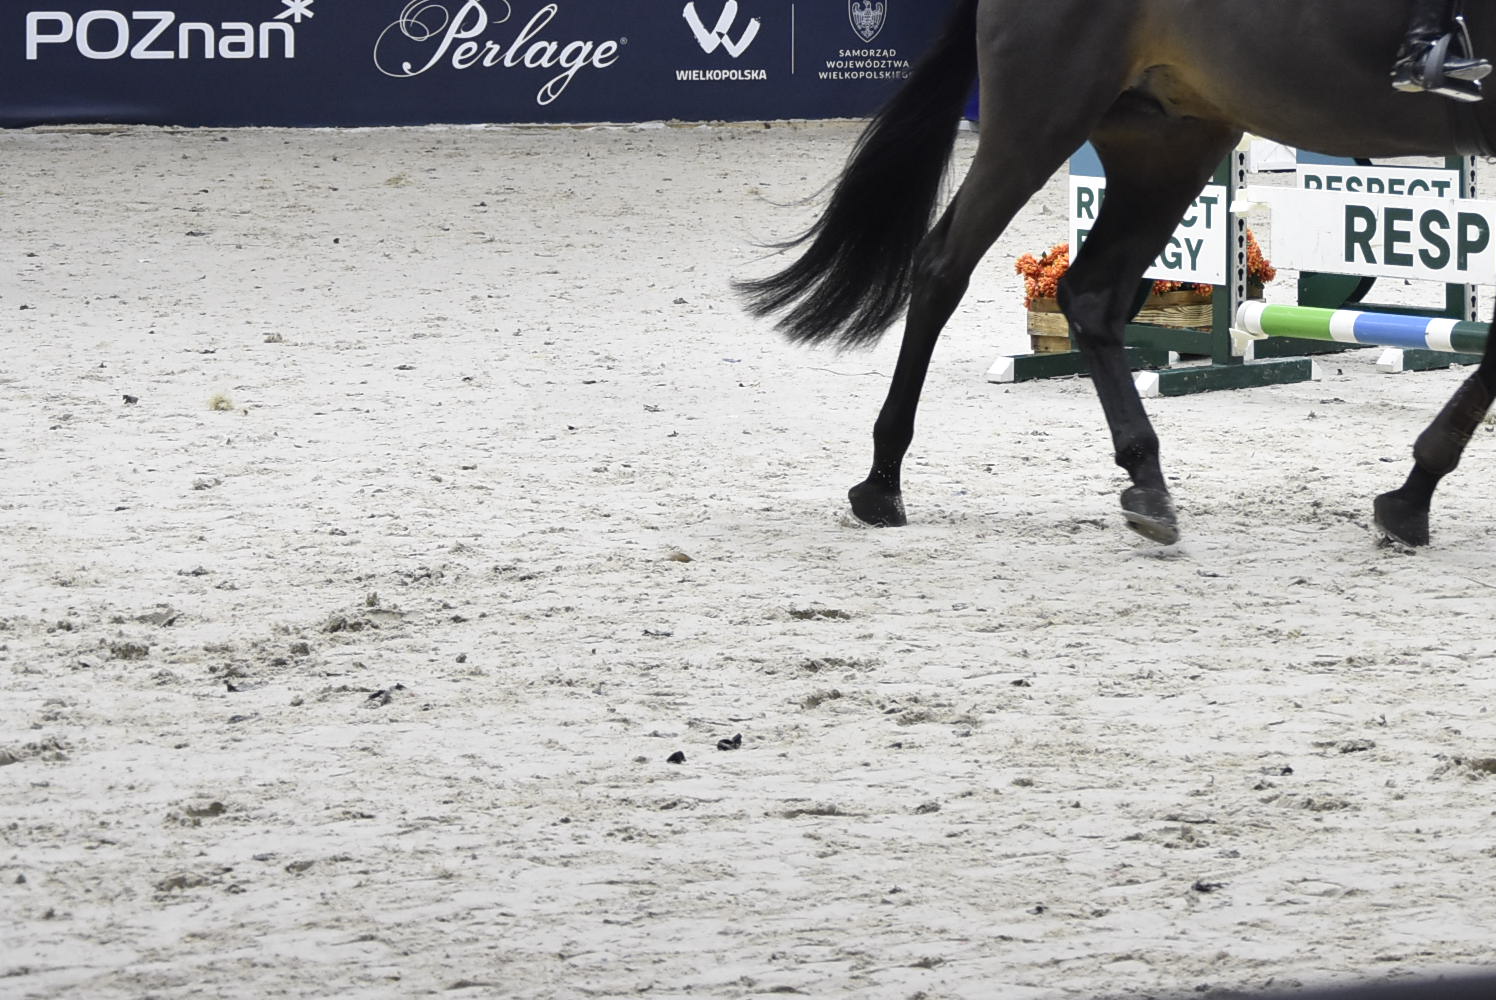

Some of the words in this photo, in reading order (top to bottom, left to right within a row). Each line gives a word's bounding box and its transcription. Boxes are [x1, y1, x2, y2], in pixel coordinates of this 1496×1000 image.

[838, 48, 897, 59] SAMORZĄD
[826, 58, 910, 69] WOJEWÓDZTWA
[675, 69, 768, 81] WIELKOPOLSKA
[818, 71, 912, 80] WIELKOPOLSKIEG
